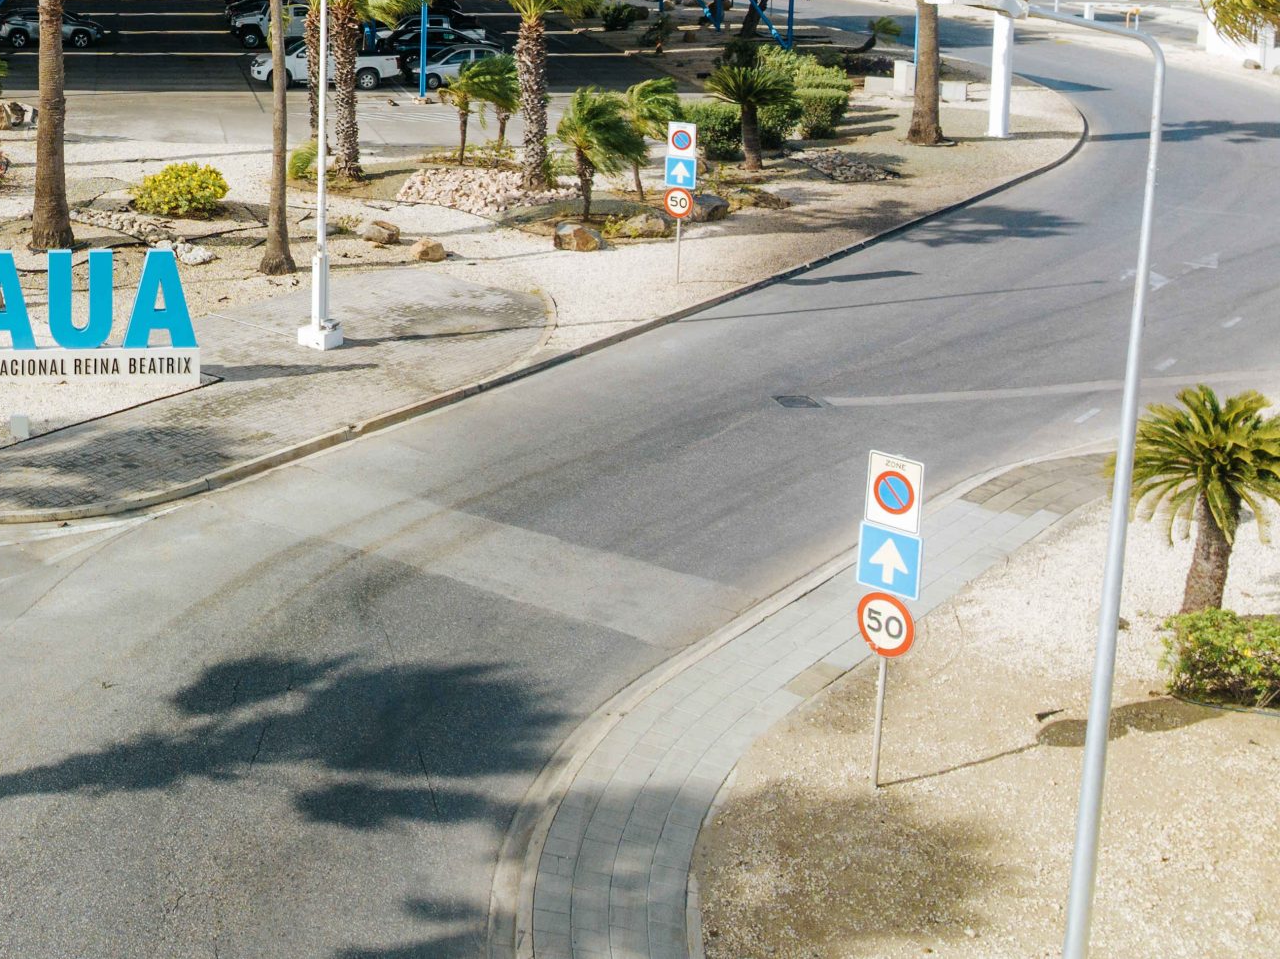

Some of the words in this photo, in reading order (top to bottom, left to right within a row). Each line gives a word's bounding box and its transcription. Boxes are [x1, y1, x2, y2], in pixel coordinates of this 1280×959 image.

[670, 196, 688, 208] 50
[73, 358, 120, 376] REINA
[128, 357, 192, 375] BEATRIX
[885, 459, 907, 472] ZONE
[867, 608, 903, 640] 50
